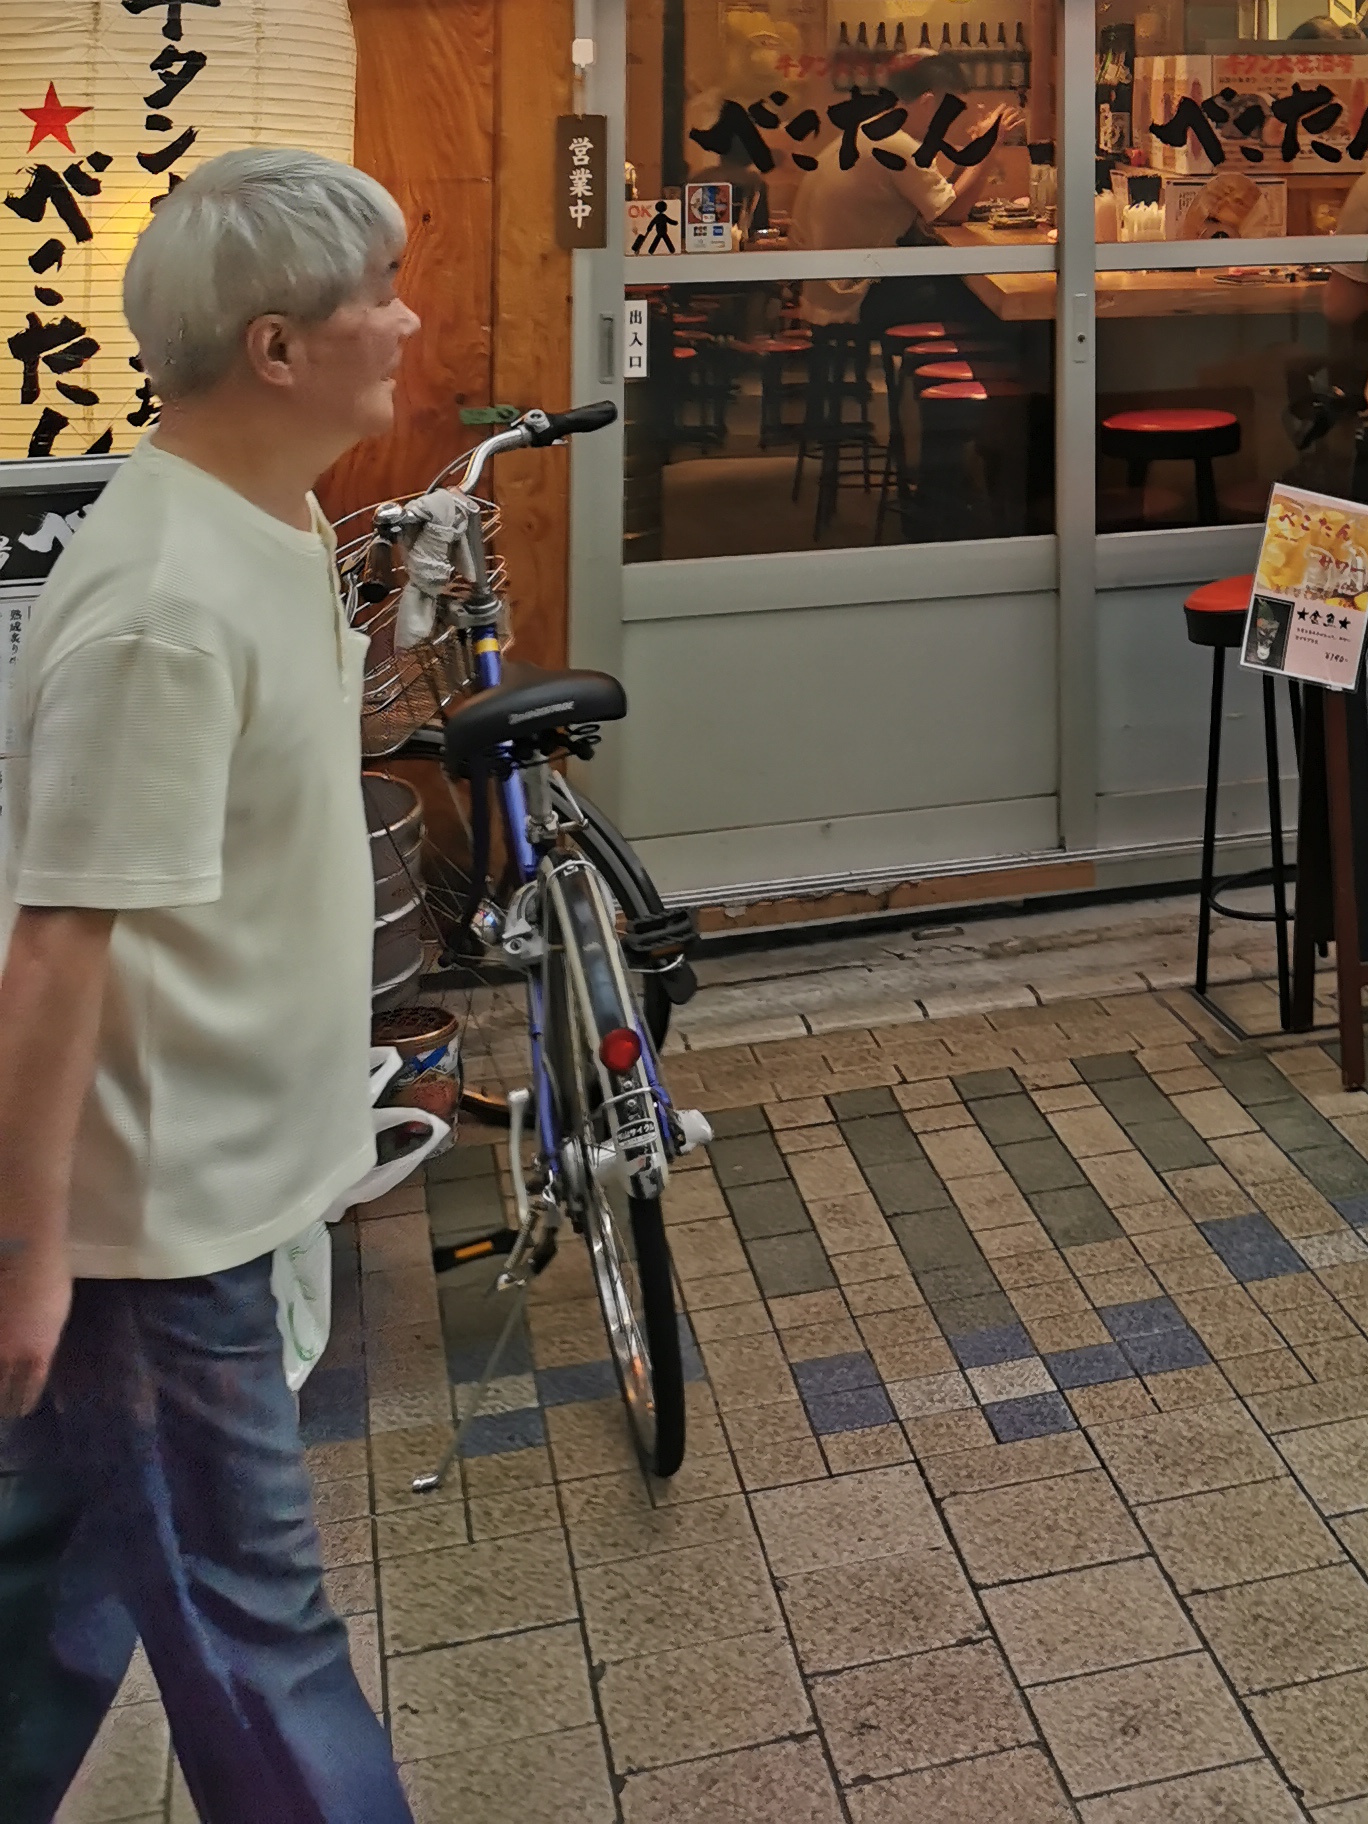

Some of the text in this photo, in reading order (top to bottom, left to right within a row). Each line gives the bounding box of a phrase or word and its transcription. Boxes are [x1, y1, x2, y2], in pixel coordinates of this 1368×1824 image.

[689, 90, 1003, 173] べこたん
[567, 136, 595, 230] 営業中
[628, 204, 652, 219] OK
[628, 308, 643, 369] 出入口
